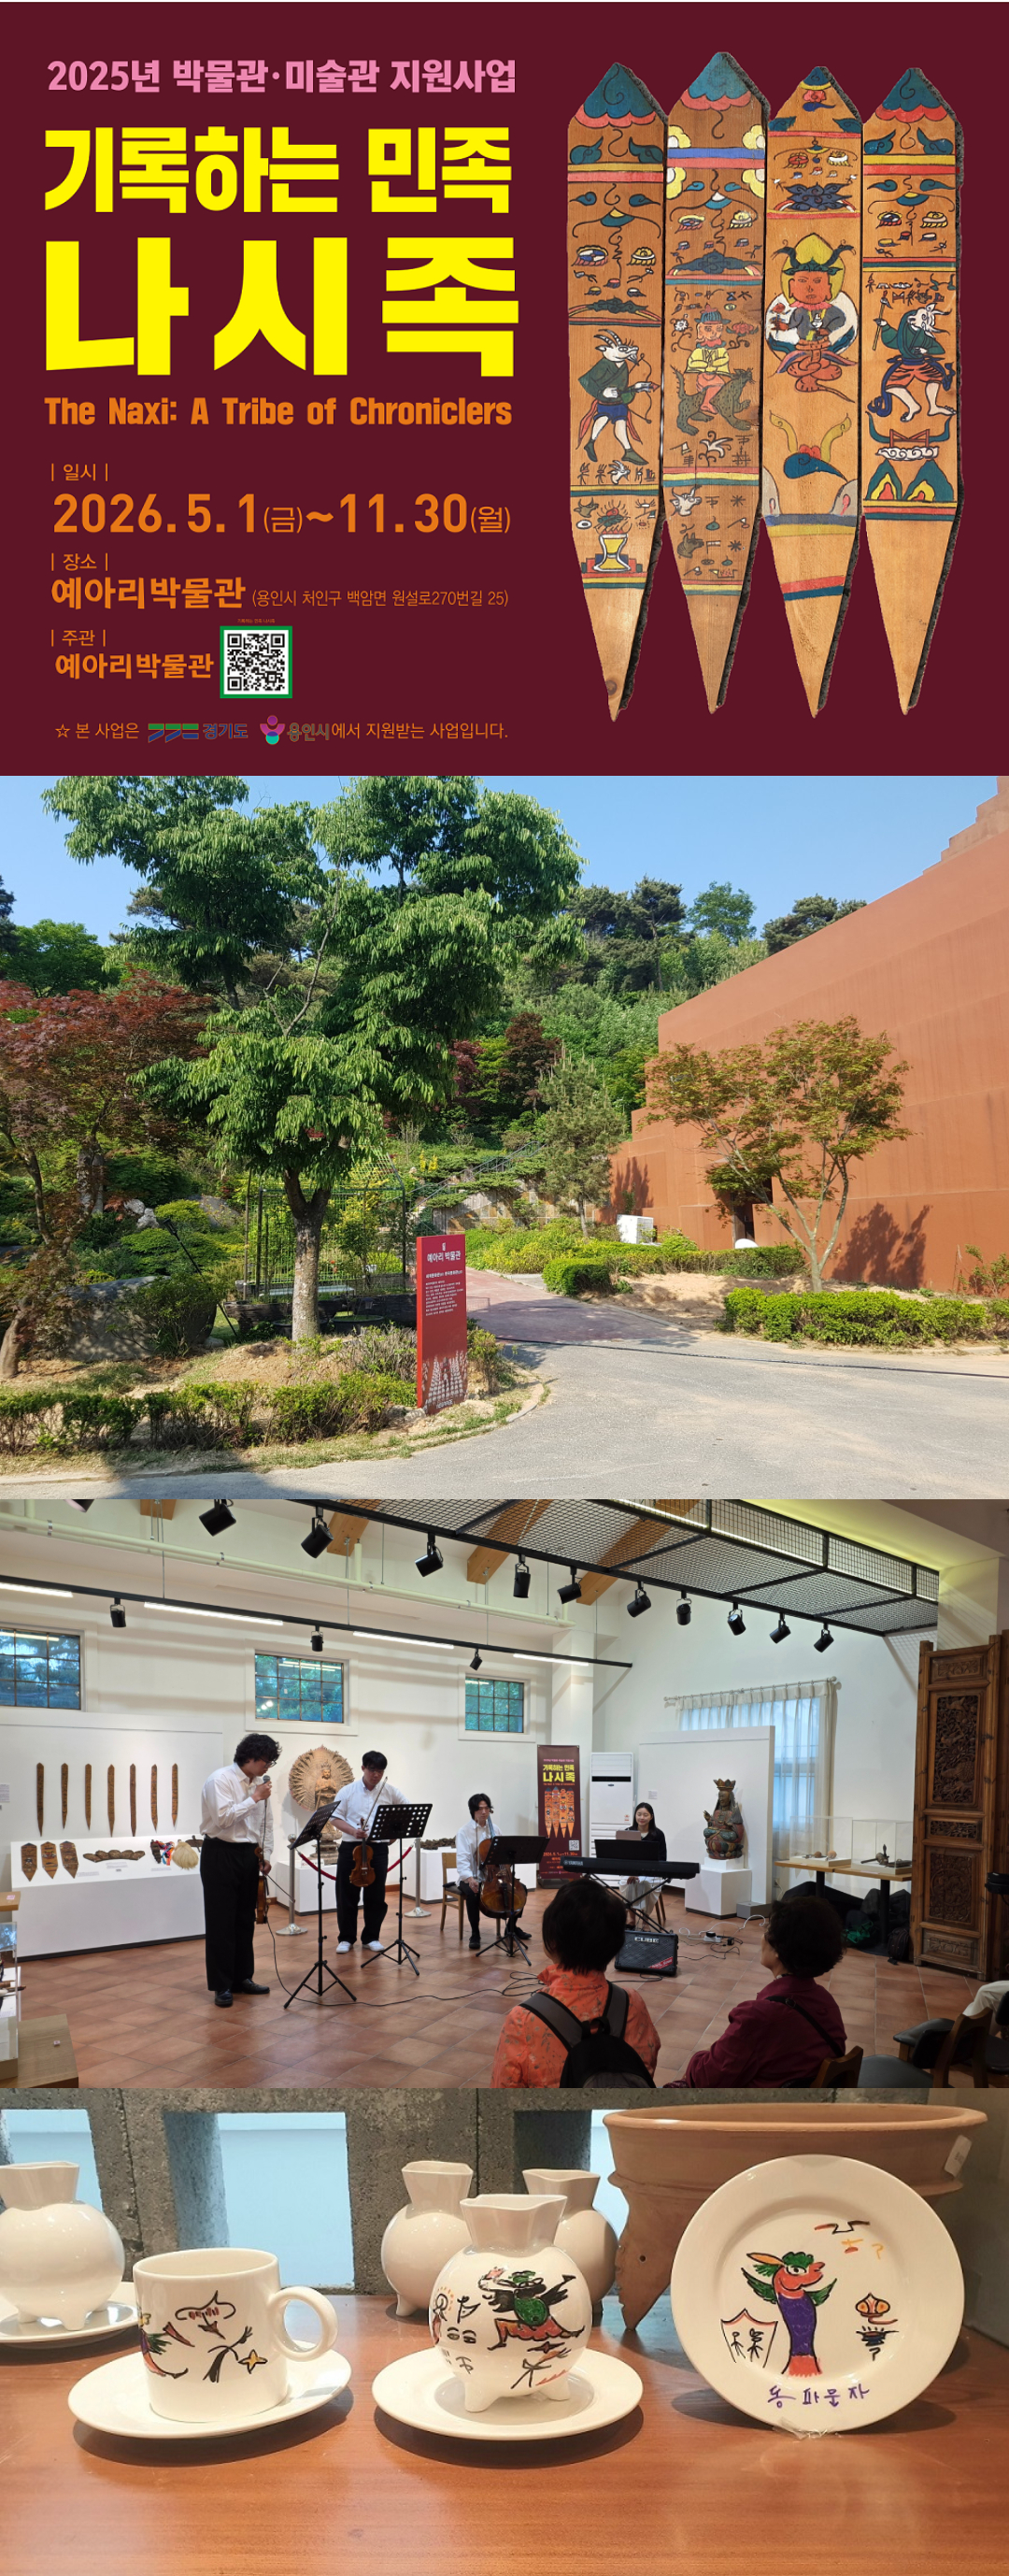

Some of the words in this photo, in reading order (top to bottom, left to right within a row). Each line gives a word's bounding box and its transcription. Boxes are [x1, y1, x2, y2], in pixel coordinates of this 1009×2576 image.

[48, 60, 160, 93] 2025년
[390, 59, 515, 93] 지원사업
[45, 126, 339, 213] 기록하는
[368, 127, 512, 213] 민족
[44, 397, 95, 425] The
[109, 397, 177, 424] Naxi:
[191, 397, 209, 424] A
[221, 397, 293, 425] Tribe
[307, 397, 336, 425] of
[350, 397, 512, 425] Chroniclers
[51, 577, 246, 609] 예아리박물관
[252, 590, 296, 607] (용인시
[303, 591, 342, 606] 처인구
[348, 590, 386, 606] 백암면
[392, 590, 482, 606] 원설로270번길
[488, 590, 508, 607] 25)
[55, 653, 214, 680] 예아리박물관
[76, 723, 90, 738] 본
[95, 723, 139, 738] 사업은
[203, 723, 248, 739] 경기도
[366, 723, 424, 738] 지원받는
[430, 723, 507, 738] 사업입니다.
[427, 1252, 444, 1263] 예아리
[445, 1251, 461, 1261] 박물관
